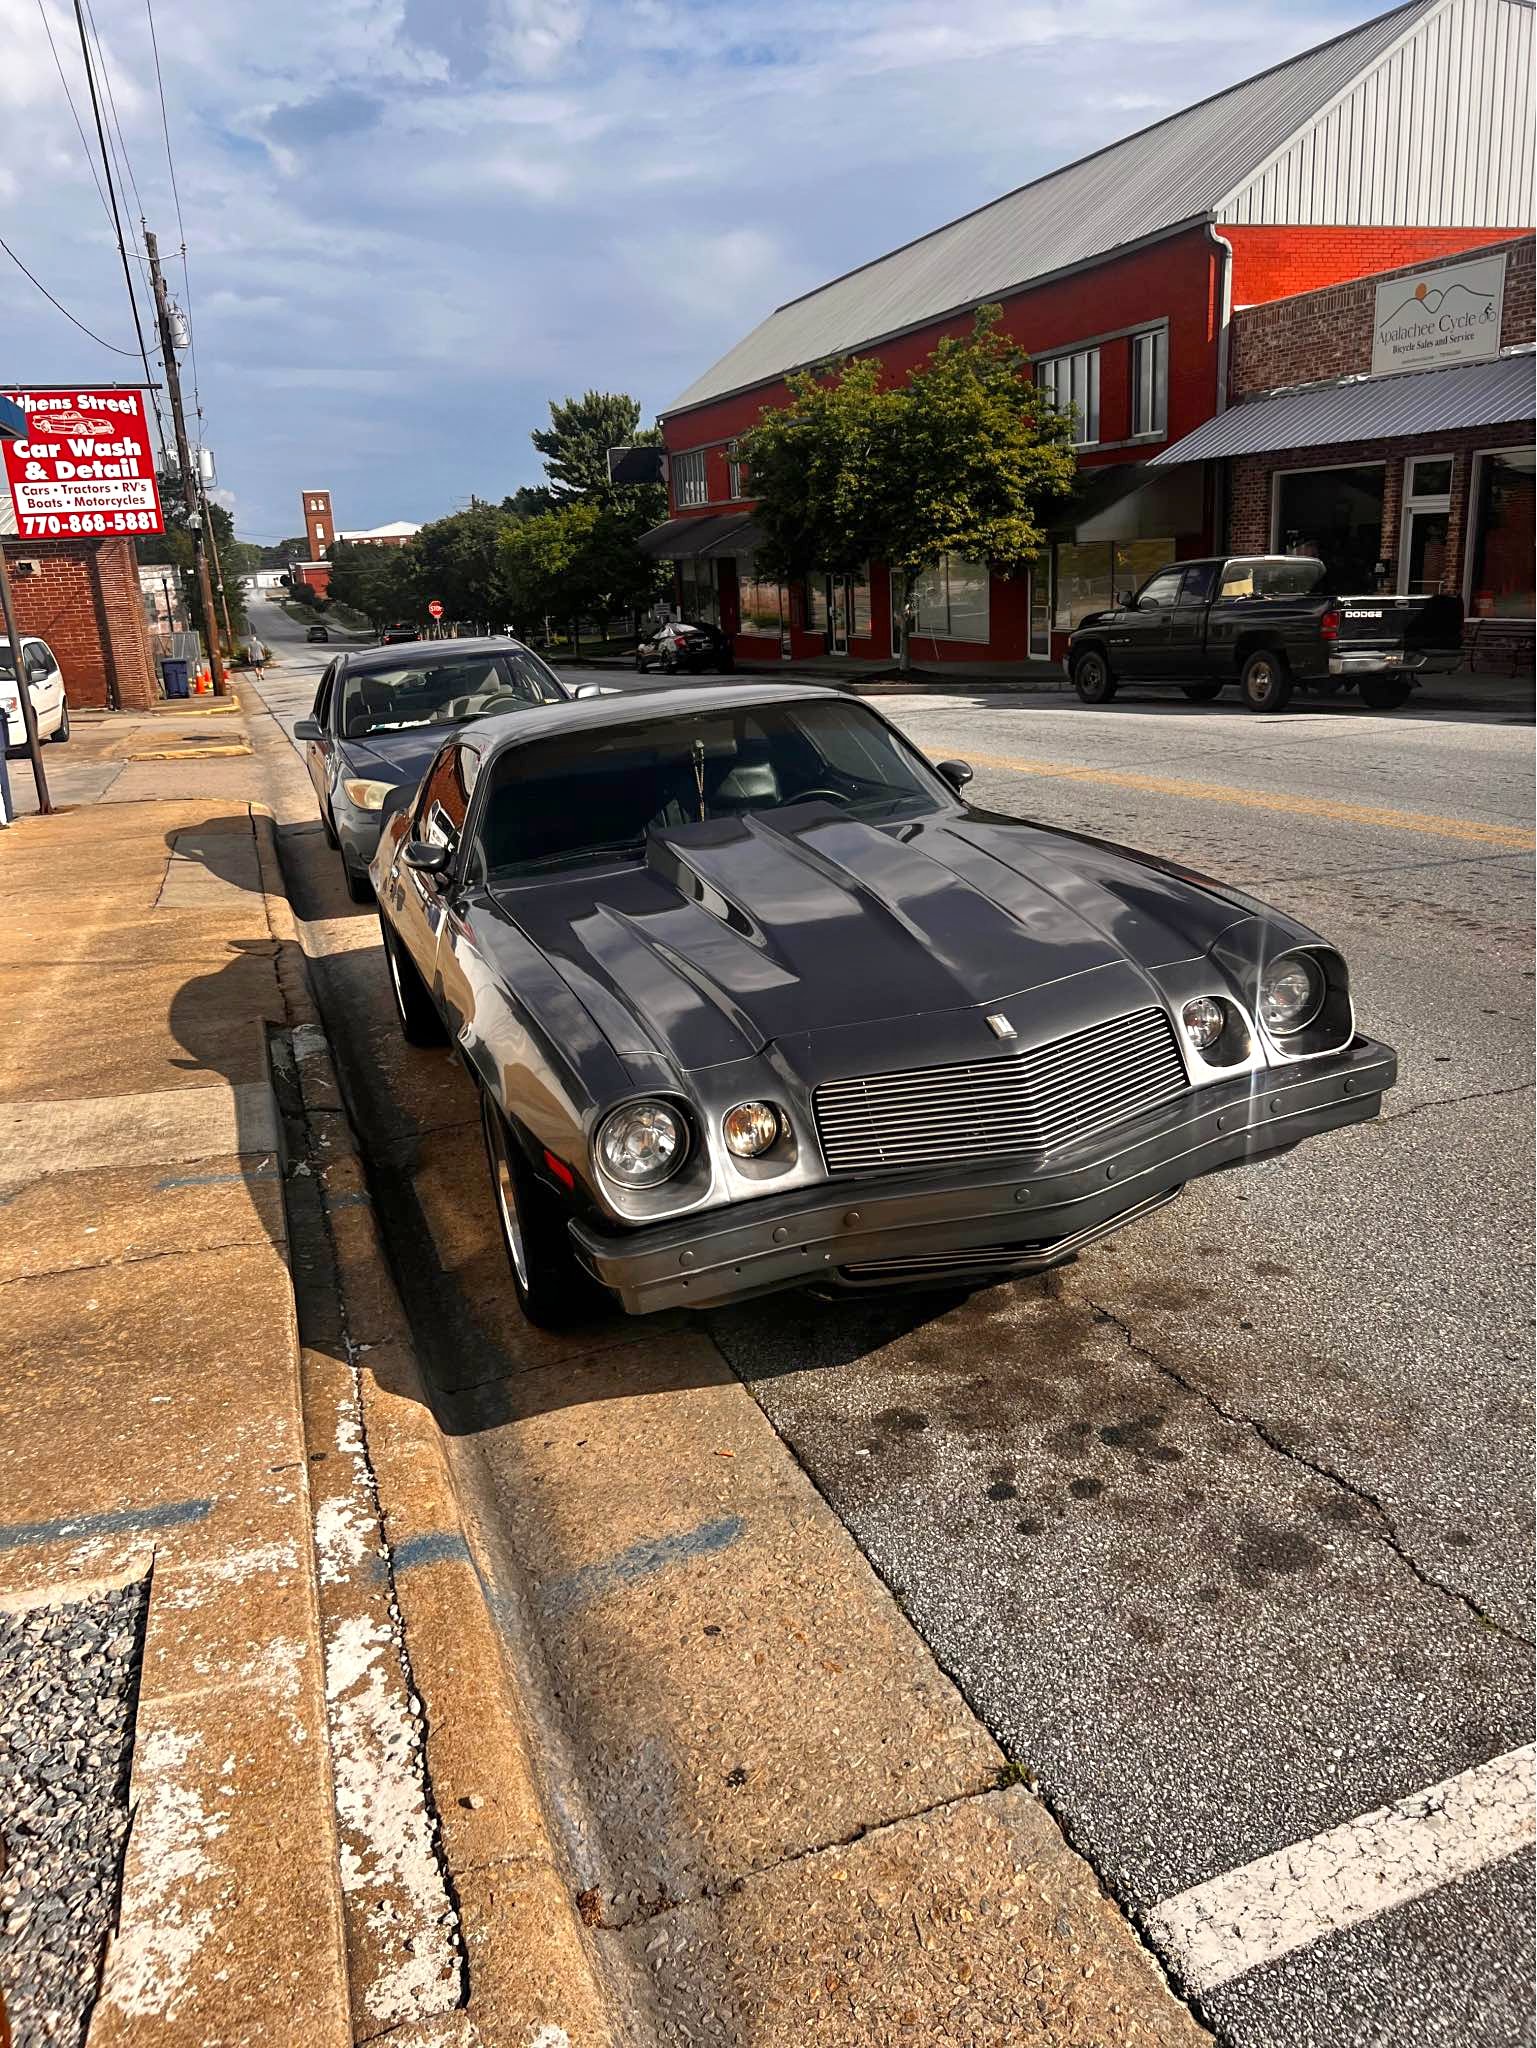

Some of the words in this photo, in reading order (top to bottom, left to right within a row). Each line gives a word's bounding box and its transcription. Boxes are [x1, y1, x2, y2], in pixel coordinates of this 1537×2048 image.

[1377, 322, 1435, 345] Apalachee
[1438, 313, 1476, 333] Cycle
[1392, 343, 1415, 354] Bicycle
[1416, 340, 1434, 350] Sales
[1435, 336, 1448, 346] and
[1449, 333, 1475, 344] Service
[6, 394, 73, 413] thens
[76, 394, 138, 416] Street
[13, 440, 61, 459] Car
[67, 437, 142, 457] Wash
[25, 461, 50, 480] &
[55, 458, 140, 480] Detail
[22, 485, 50, 496] Cars
[60, 483, 111, 495] Tractors
[122, 482, 147, 493] RV's
[27, 498, 63, 509] Boats
[74, 495, 146, 508] Motorcycles
[23, 512, 158, 535] 770-868-5881
